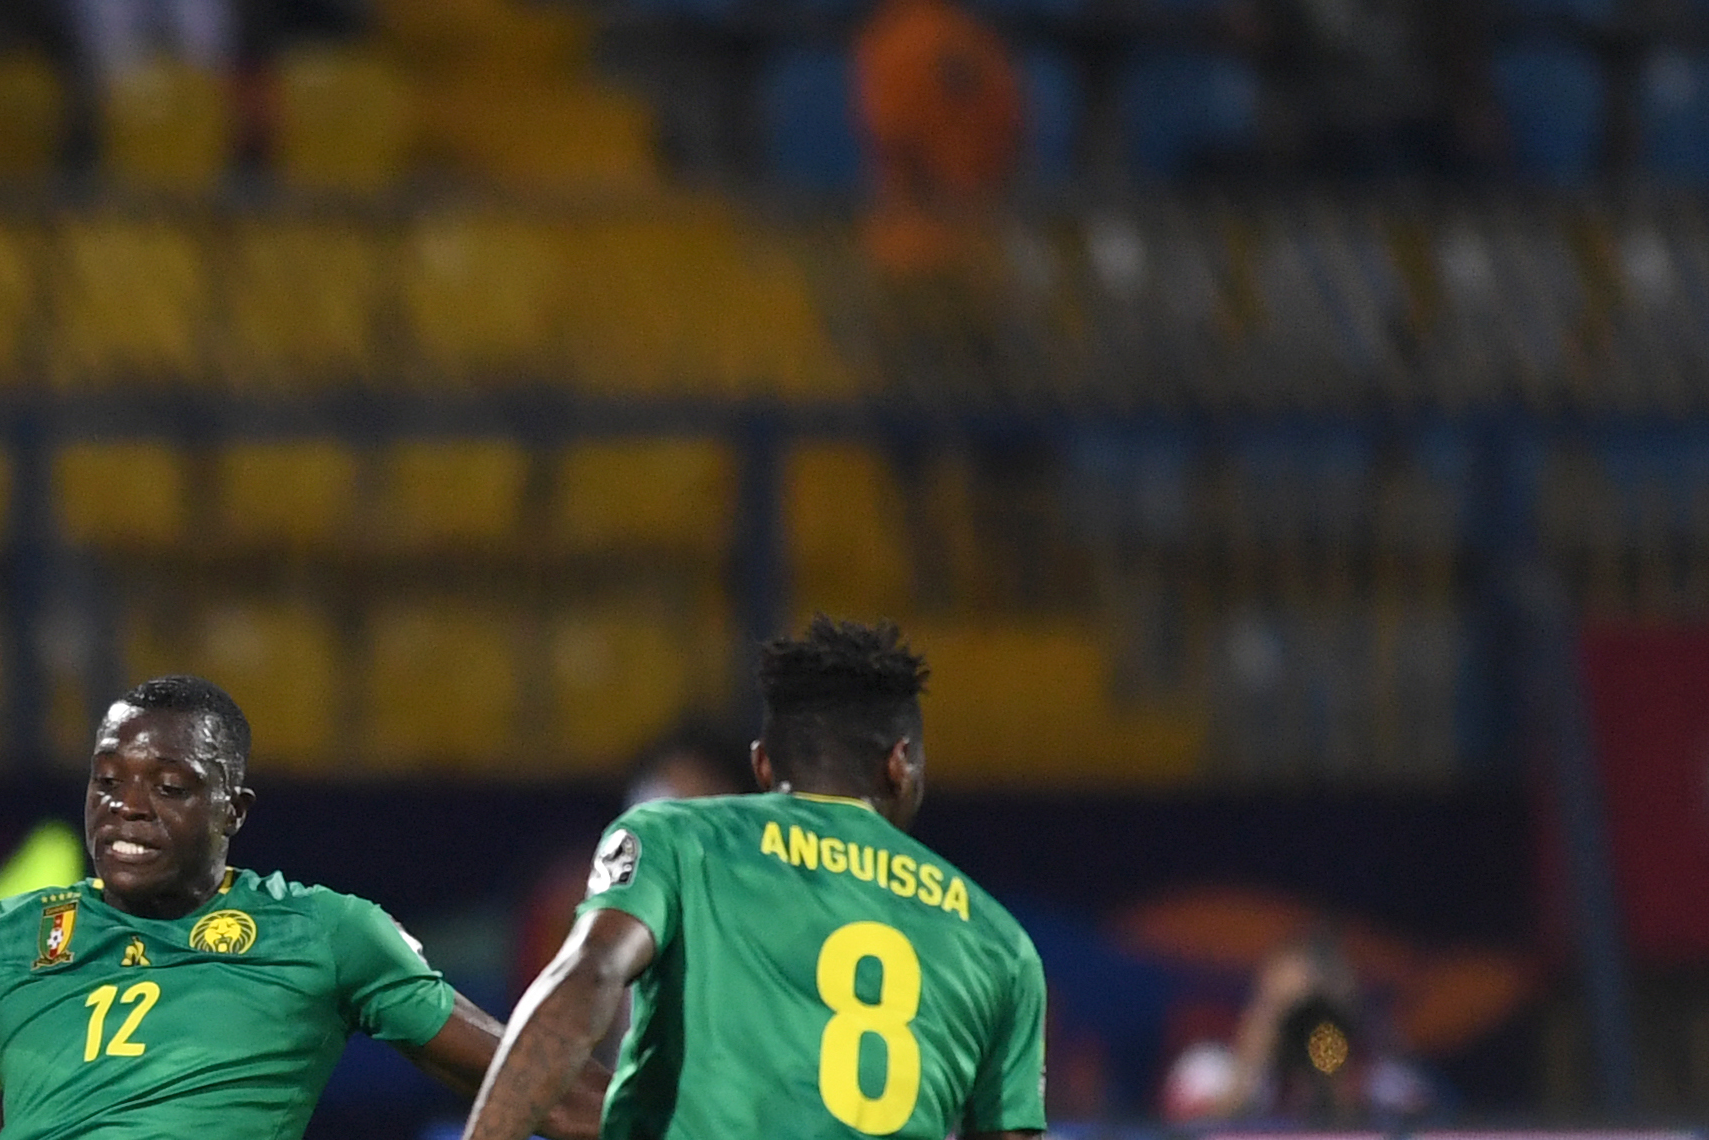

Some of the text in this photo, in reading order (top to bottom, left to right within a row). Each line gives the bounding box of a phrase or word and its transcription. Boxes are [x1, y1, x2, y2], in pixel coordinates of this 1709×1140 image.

[760, 821, 971, 921] ANGUISSA
[83, 981, 161, 1062] 12
[816, 921, 922, 1135] 8
